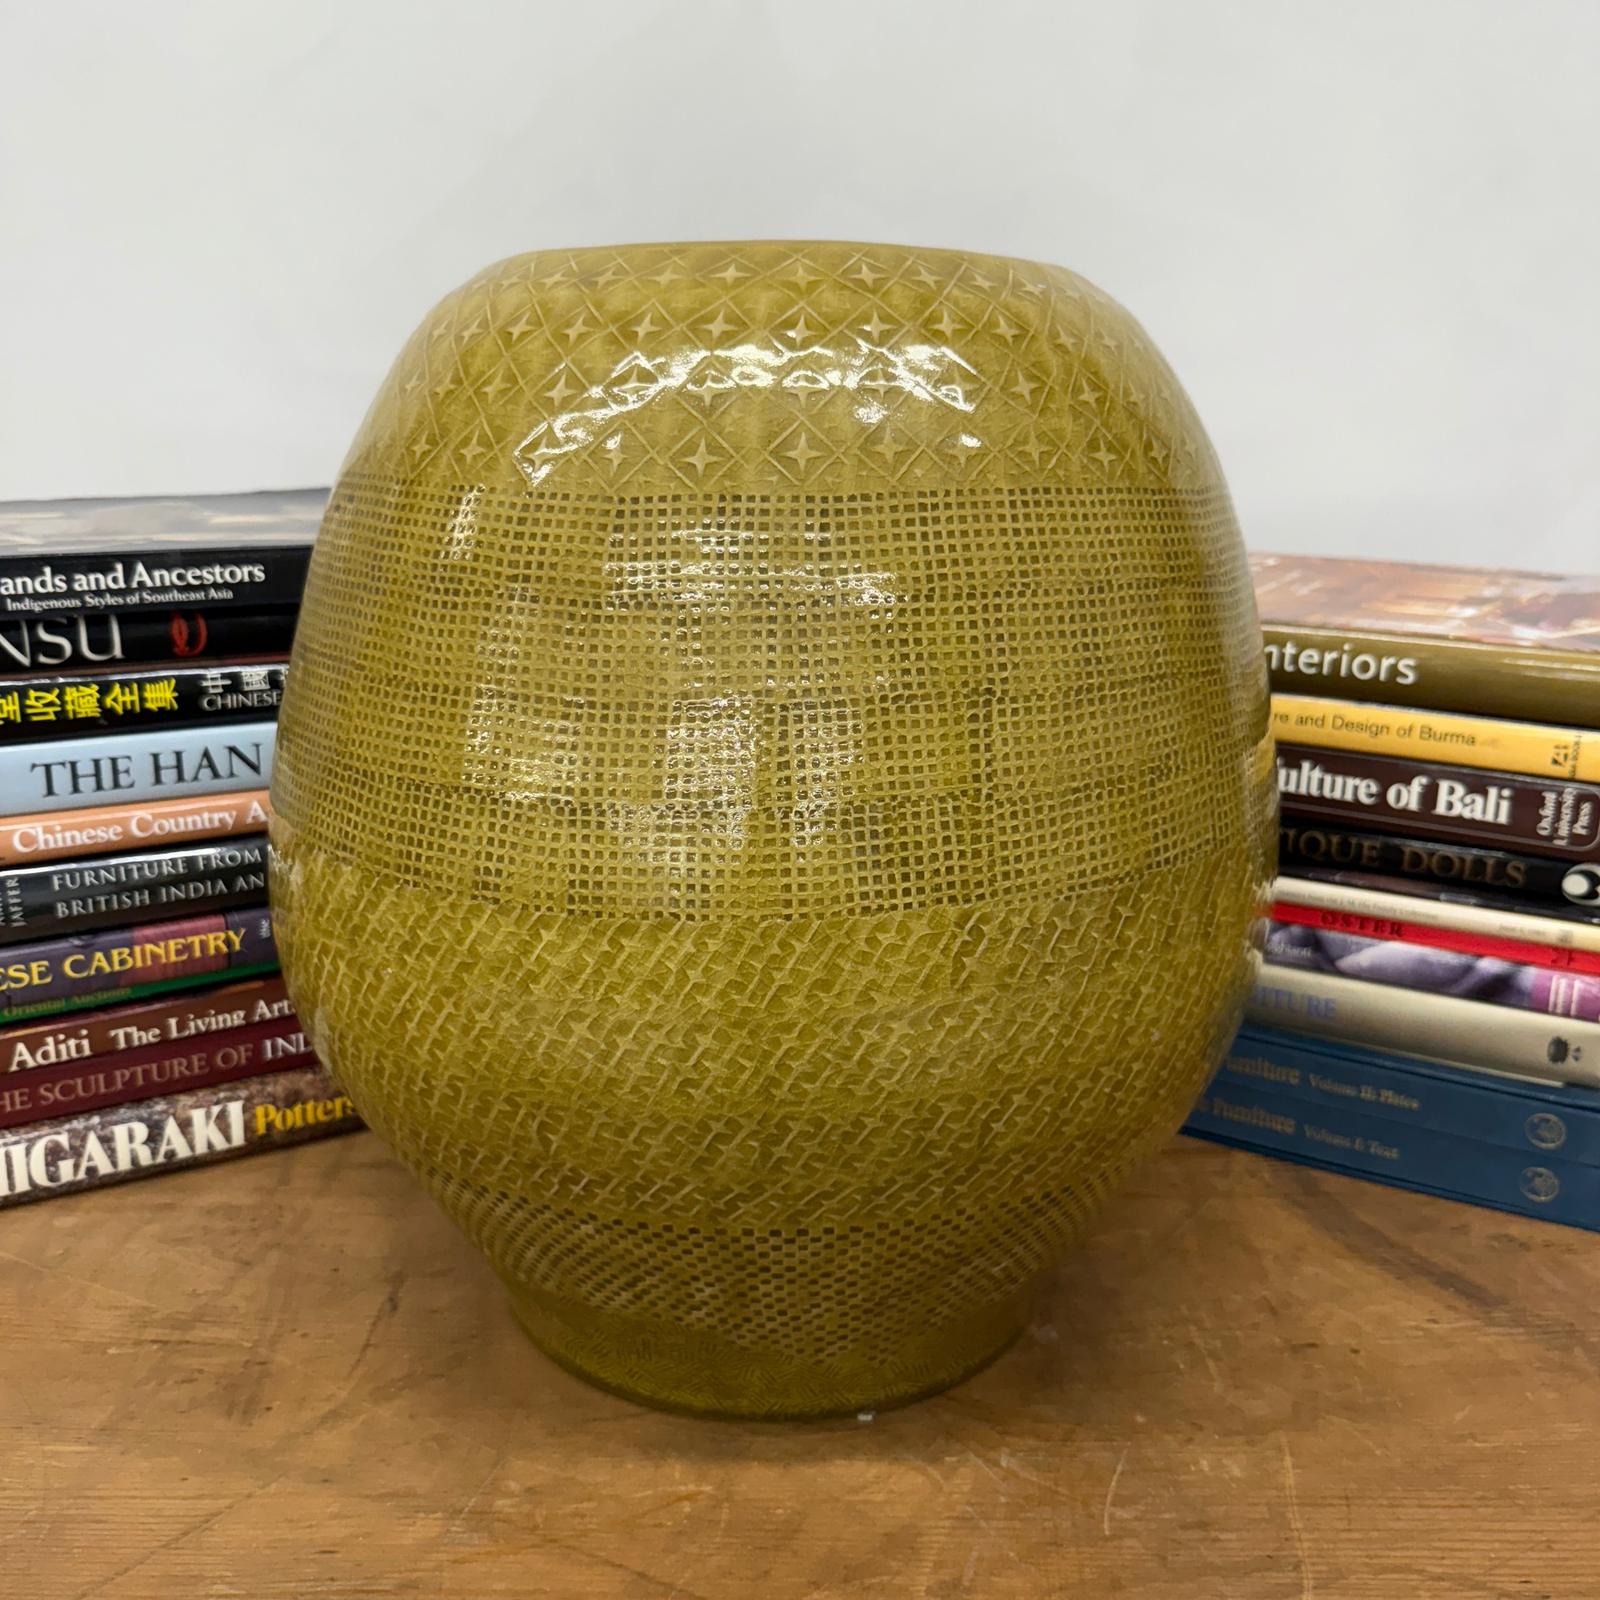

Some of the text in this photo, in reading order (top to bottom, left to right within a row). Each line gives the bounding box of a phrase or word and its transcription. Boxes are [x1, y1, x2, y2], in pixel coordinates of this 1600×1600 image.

[0, 561, 266, 595] ands and Ancestors
[7, 586, 234, 613] Indigenous Styles of Southeast Asia
[202, 690, 281, 712] CHINESE
[1295, 714, 1326, 730] and
[1331, 714, 1390, 738] Design
[1397, 722, 1413, 739] of
[1419, 726, 1477, 747] Burma
[31, 743, 262, 798] THE HAN
[1276, 757, 1515, 826] ulture of Bali
[12, 824, 124, 854] Chinese
[130, 810, 238, 840] Country
[1536, 790, 1559, 837] Oxford
[1572, 800, 1593, 837] Press
[52, 848, 263, 893] FURNITURE FROM
[1401, 847, 1527, 889] DOLLS
[5, 877, 27, 928] JAFFER
[55, 886, 151, 919] BRITISH
[160, 878, 228, 904] INDIA
[63, 927, 247, 980] CABINETRY
[8, 1029, 93, 1073] Aditi
[110, 1025, 162, 1051] The
[167, 1008, 247, 1040] Living
[39, 1053, 210, 1106] SCULPTURE
[215, 1044, 254, 1071] OF
